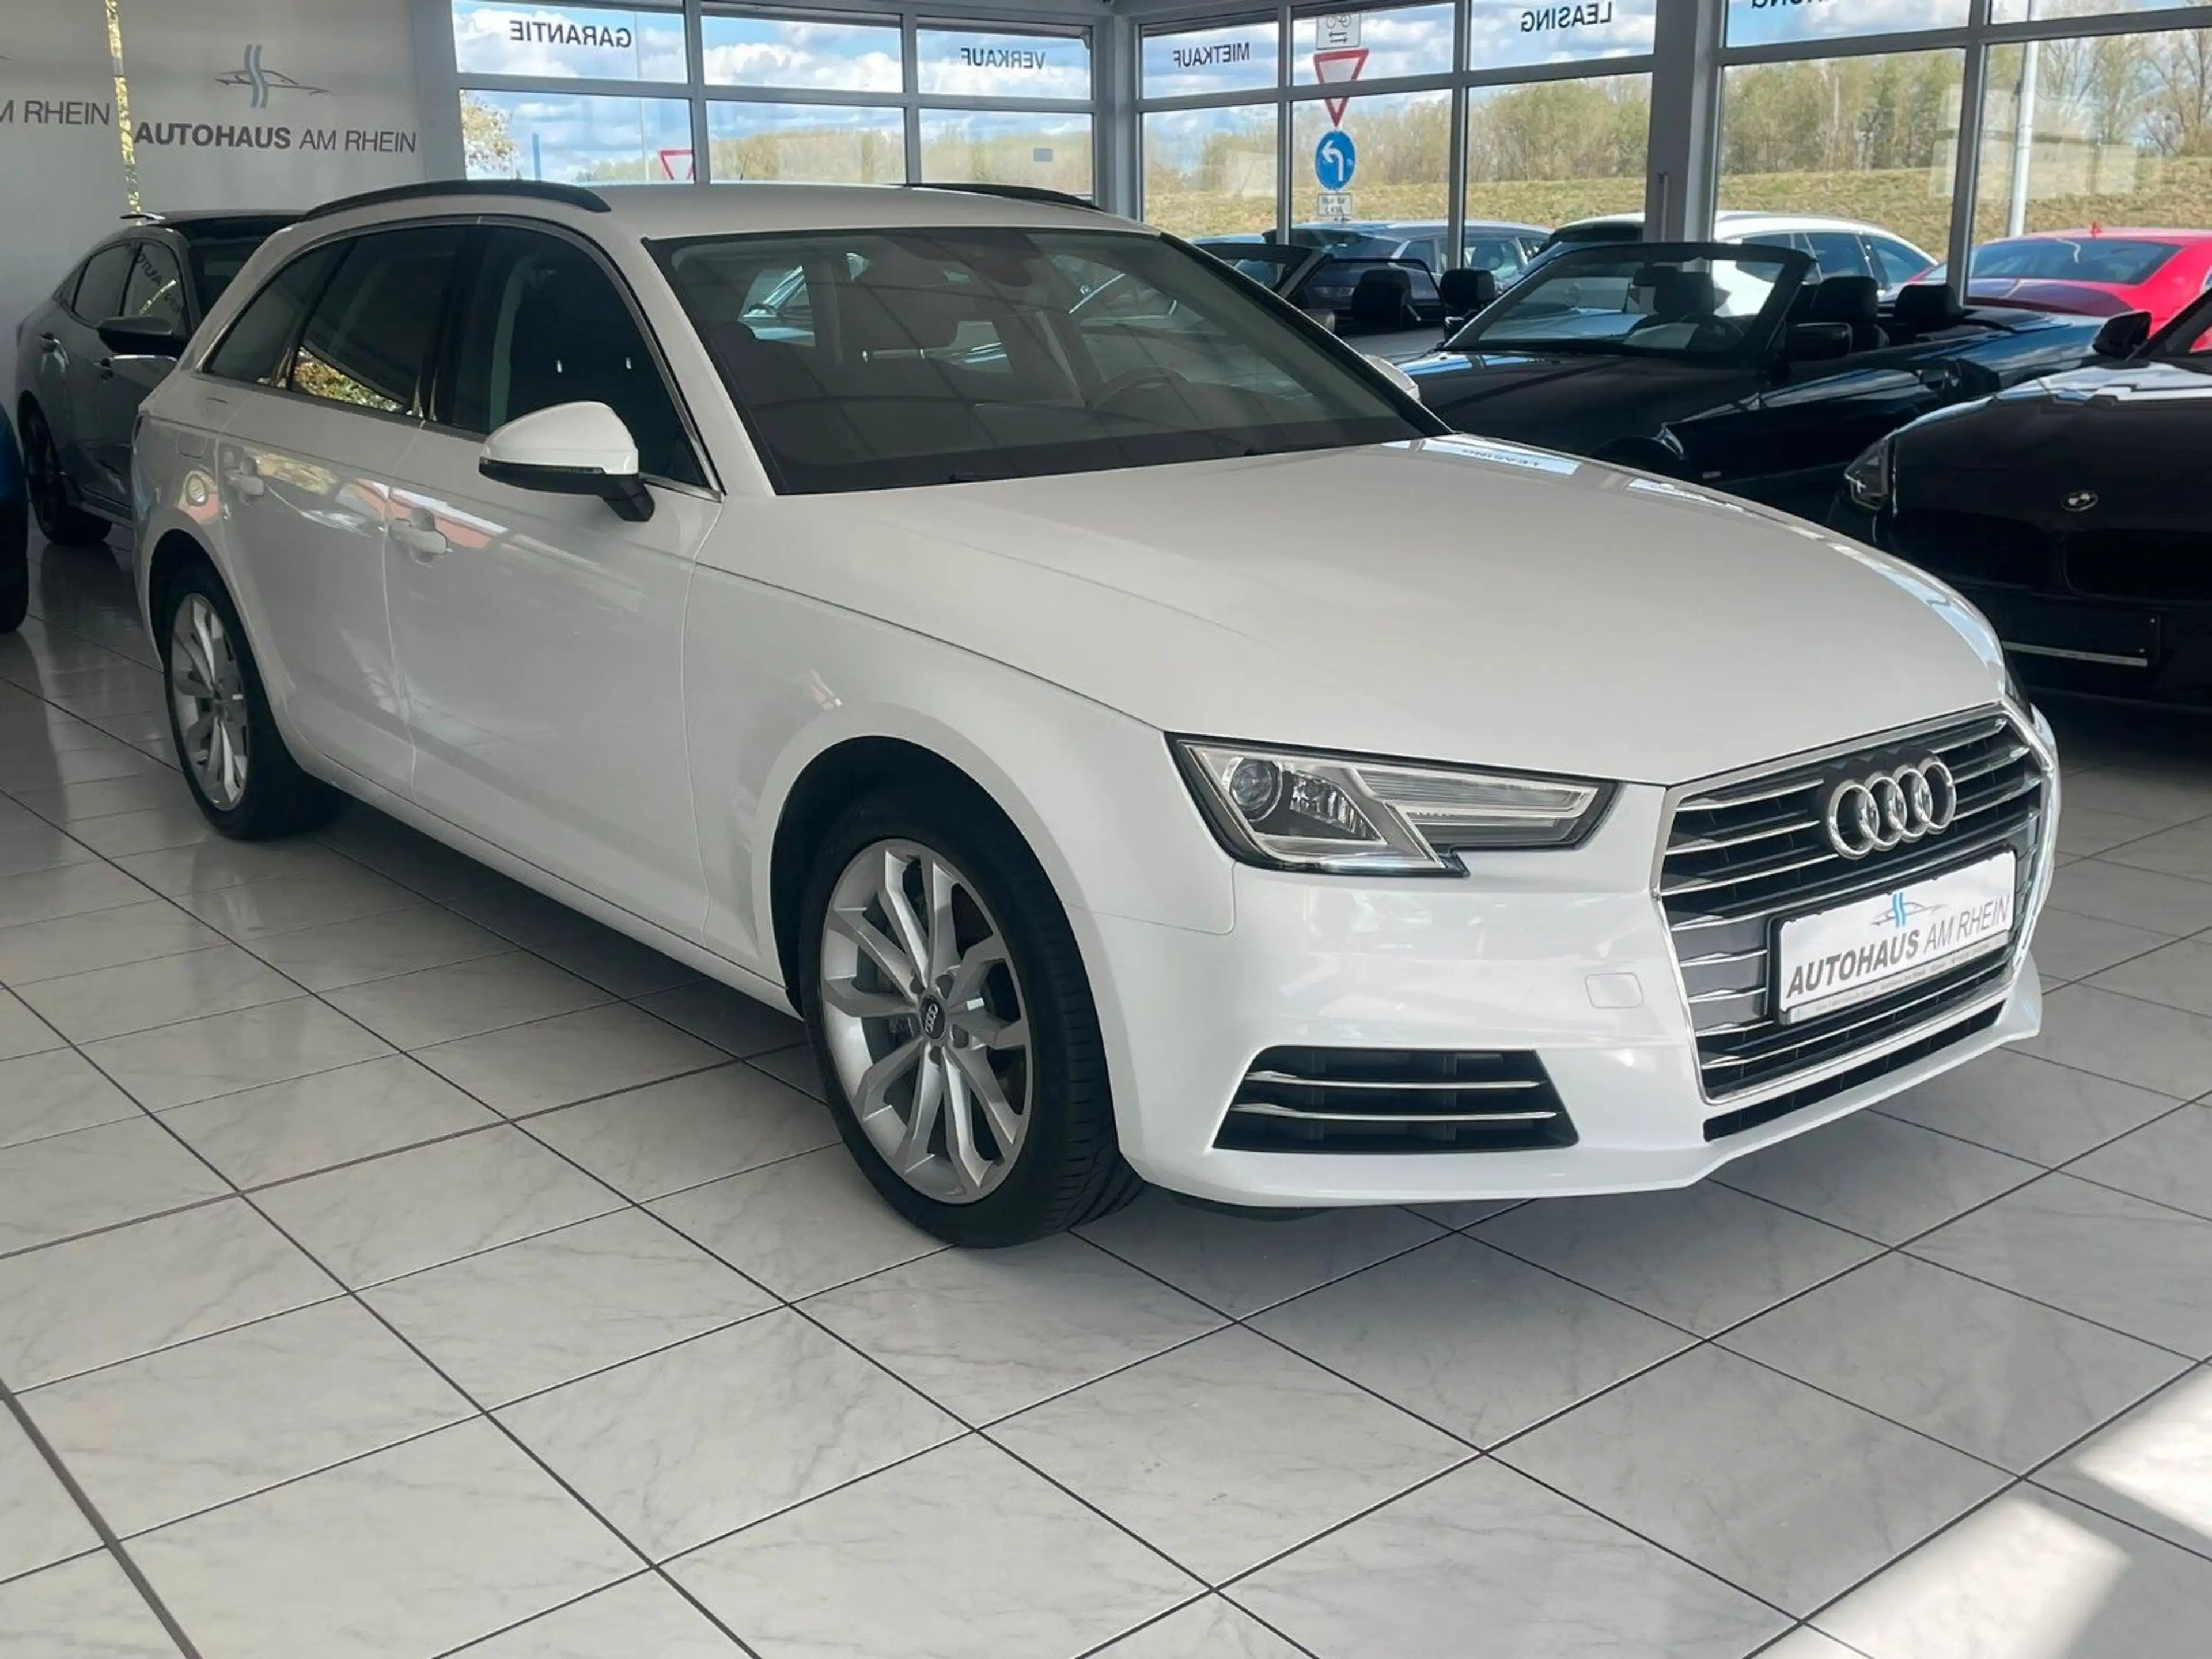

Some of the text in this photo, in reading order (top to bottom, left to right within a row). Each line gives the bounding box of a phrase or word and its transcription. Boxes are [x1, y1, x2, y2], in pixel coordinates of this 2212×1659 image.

[0, 100, 110, 125] M RHEIN
[134, 122, 416, 153] AUTOHAUS AM RHEIN
[1786, 929, 1920, 999] AUTOHAUS
[1923, 916, 1955, 955] AM
[1957, 894, 2010, 942] RHEIN
